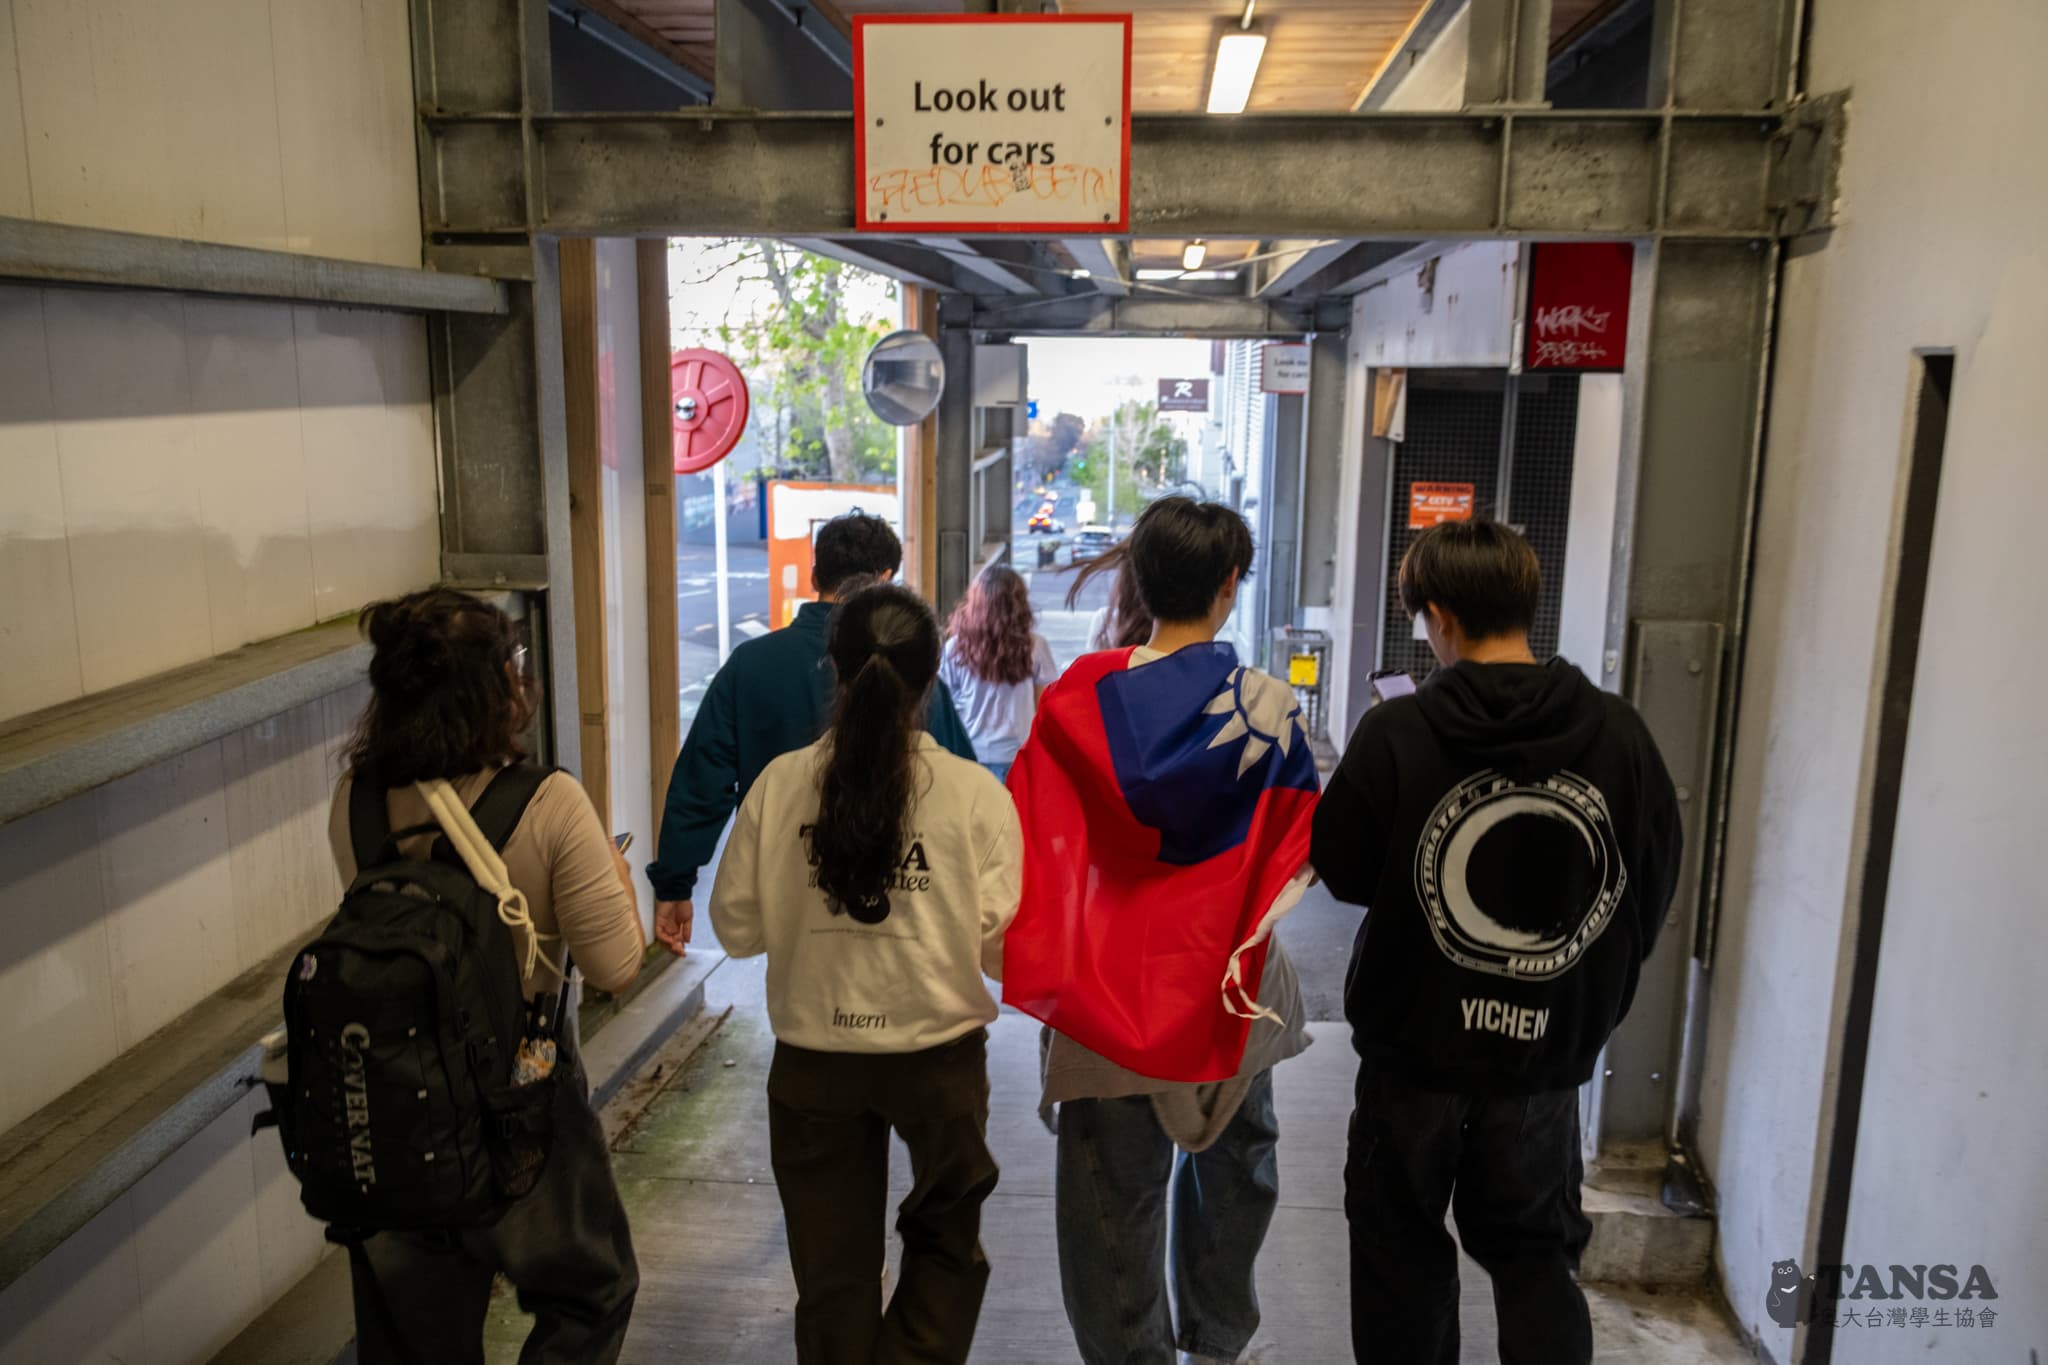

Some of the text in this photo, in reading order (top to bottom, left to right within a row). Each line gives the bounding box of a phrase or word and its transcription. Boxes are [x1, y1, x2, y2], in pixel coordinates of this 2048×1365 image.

[914, 79, 1066, 112] Look out
[929, 133, 1055, 165] for cars
[1174, 381, 1193, 398] R
[832, 1006, 887, 1029] Intern
[1461, 998, 1550, 1041] YICHEN
